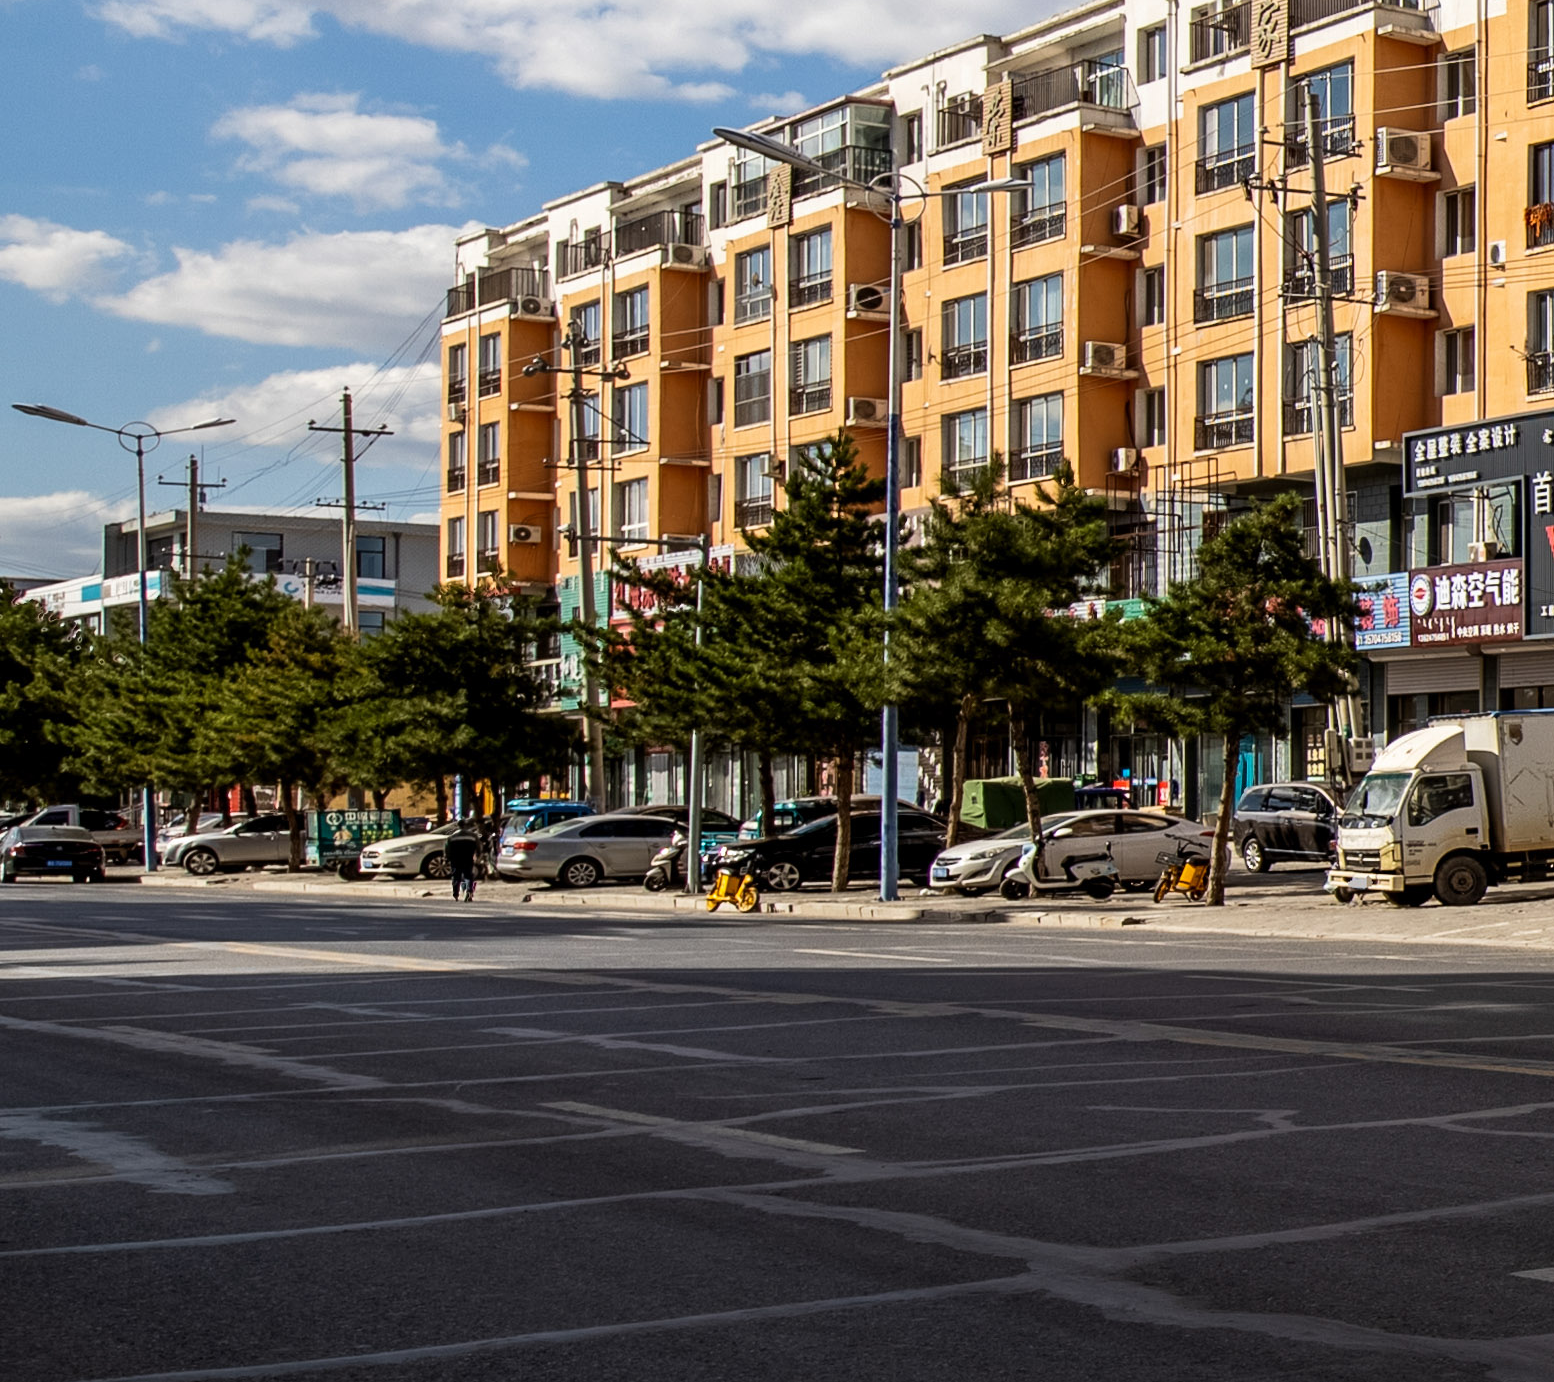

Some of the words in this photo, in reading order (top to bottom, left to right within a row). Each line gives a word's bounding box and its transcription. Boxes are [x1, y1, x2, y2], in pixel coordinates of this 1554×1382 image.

[1435, 569, 1520, 610] 迪森空气能
